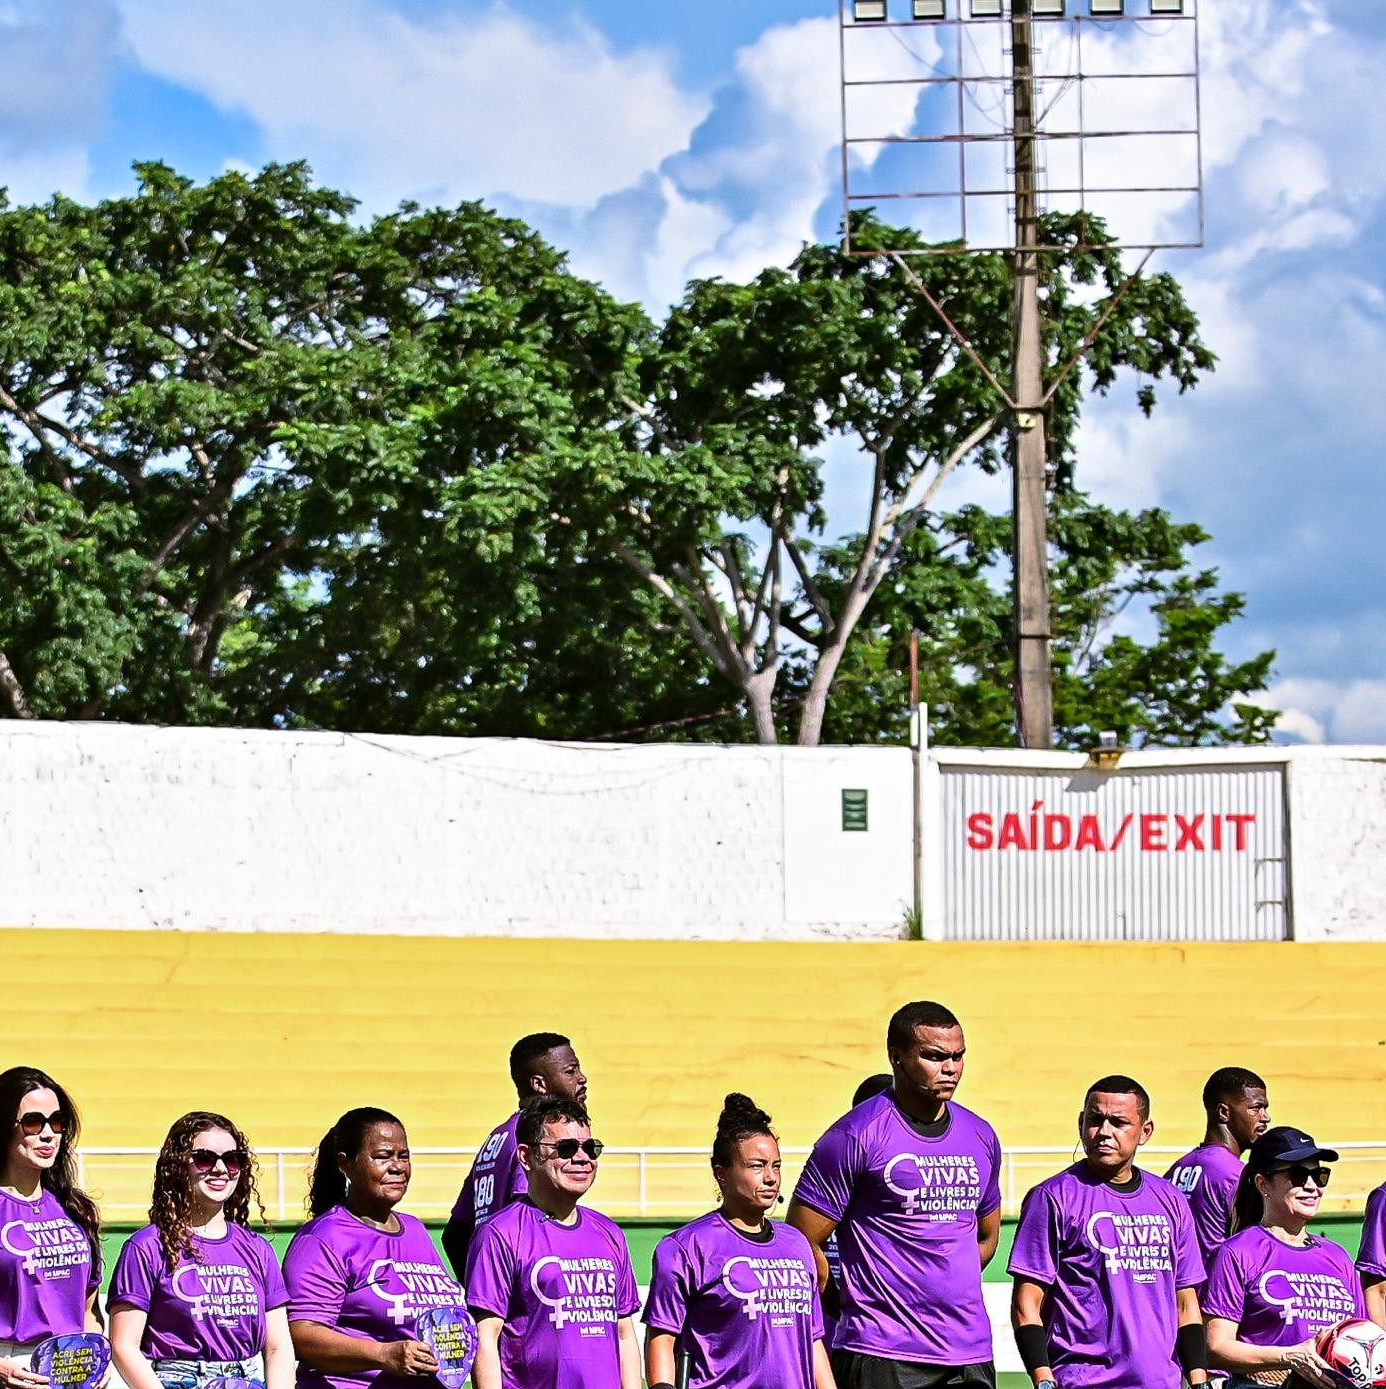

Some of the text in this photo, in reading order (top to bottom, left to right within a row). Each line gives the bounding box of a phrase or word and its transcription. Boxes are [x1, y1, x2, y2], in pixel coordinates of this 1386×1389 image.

[966, 800, 1257, 852] SAÍDA/EXIT
[915, 1156, 975, 1167] MULHERES
[919, 1168, 980, 1187] VIVAS
[1172, 1166, 1202, 1192] 190
[1114, 1214, 1168, 1226] MULHERES
[28, 1226, 84, 1247] VIVAS
[1116, 1226, 1170, 1244] VIVAS
[197, 1265, 250, 1277] MULHERES
[393, 1261, 449, 1276] MULHERES
[561, 1258, 614, 1271] MULHERES
[750, 1258, 804, 1269] MULHERES
[199, 1276, 255, 1293] VIVAS
[398, 1274, 462, 1293] VIVAS
[563, 1273, 616, 1294] VIVAS
[754, 1270, 809, 1288] VIVAS
[1286, 1272, 1343, 1288] MULHERES
[1289, 1282, 1353, 1301] VIVAS
[1297, 1308, 1352, 1322] VIOLÊNCIA
